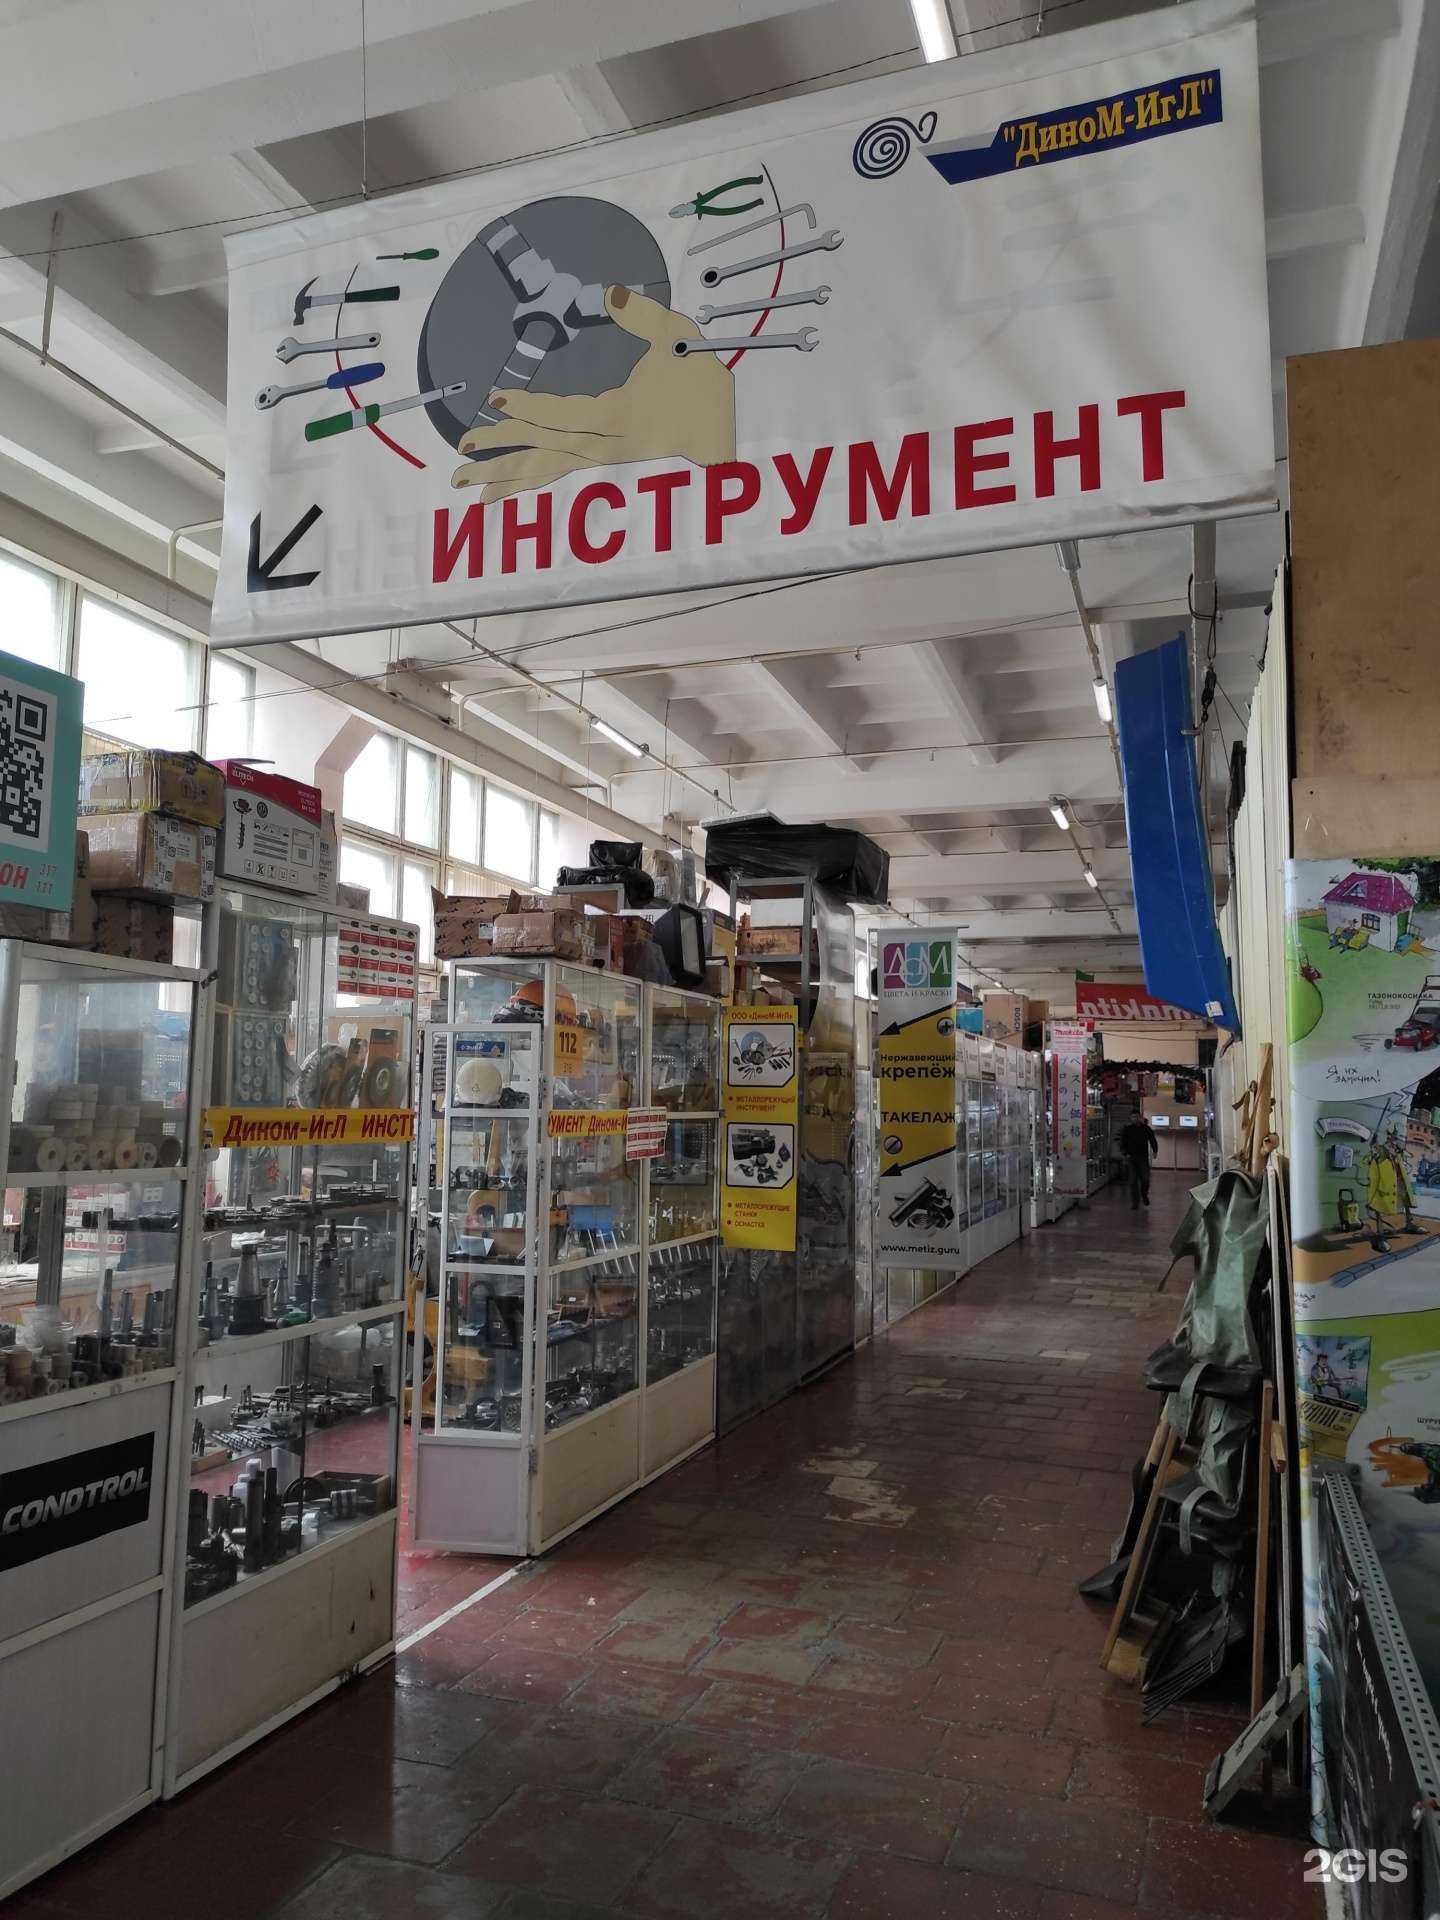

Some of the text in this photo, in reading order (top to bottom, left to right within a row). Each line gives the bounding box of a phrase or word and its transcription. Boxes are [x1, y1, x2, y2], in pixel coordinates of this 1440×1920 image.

[1002, 79, 1214, 168] "ДиноМ-ИгЛ"
[431, 390, 1187, 584] ИНСТРУМЕНТ
[731, 1011, 747, 1020] ООО
[559, 1031, 577, 1054] 112
[881, 1063, 956, 1082] крепёж
[549, 1113, 585, 1134] УМЕНТ
[588, 1114, 628, 1137] Дином-И
[881, 1111, 956, 1123] ТАКЕЛАЖ
[222, 1113, 347, 1148] Дином-ИгЛ
[880, 1245, 960, 1256] www.metiz.guru
[1, 1466, 149, 1536] CONDTROL
